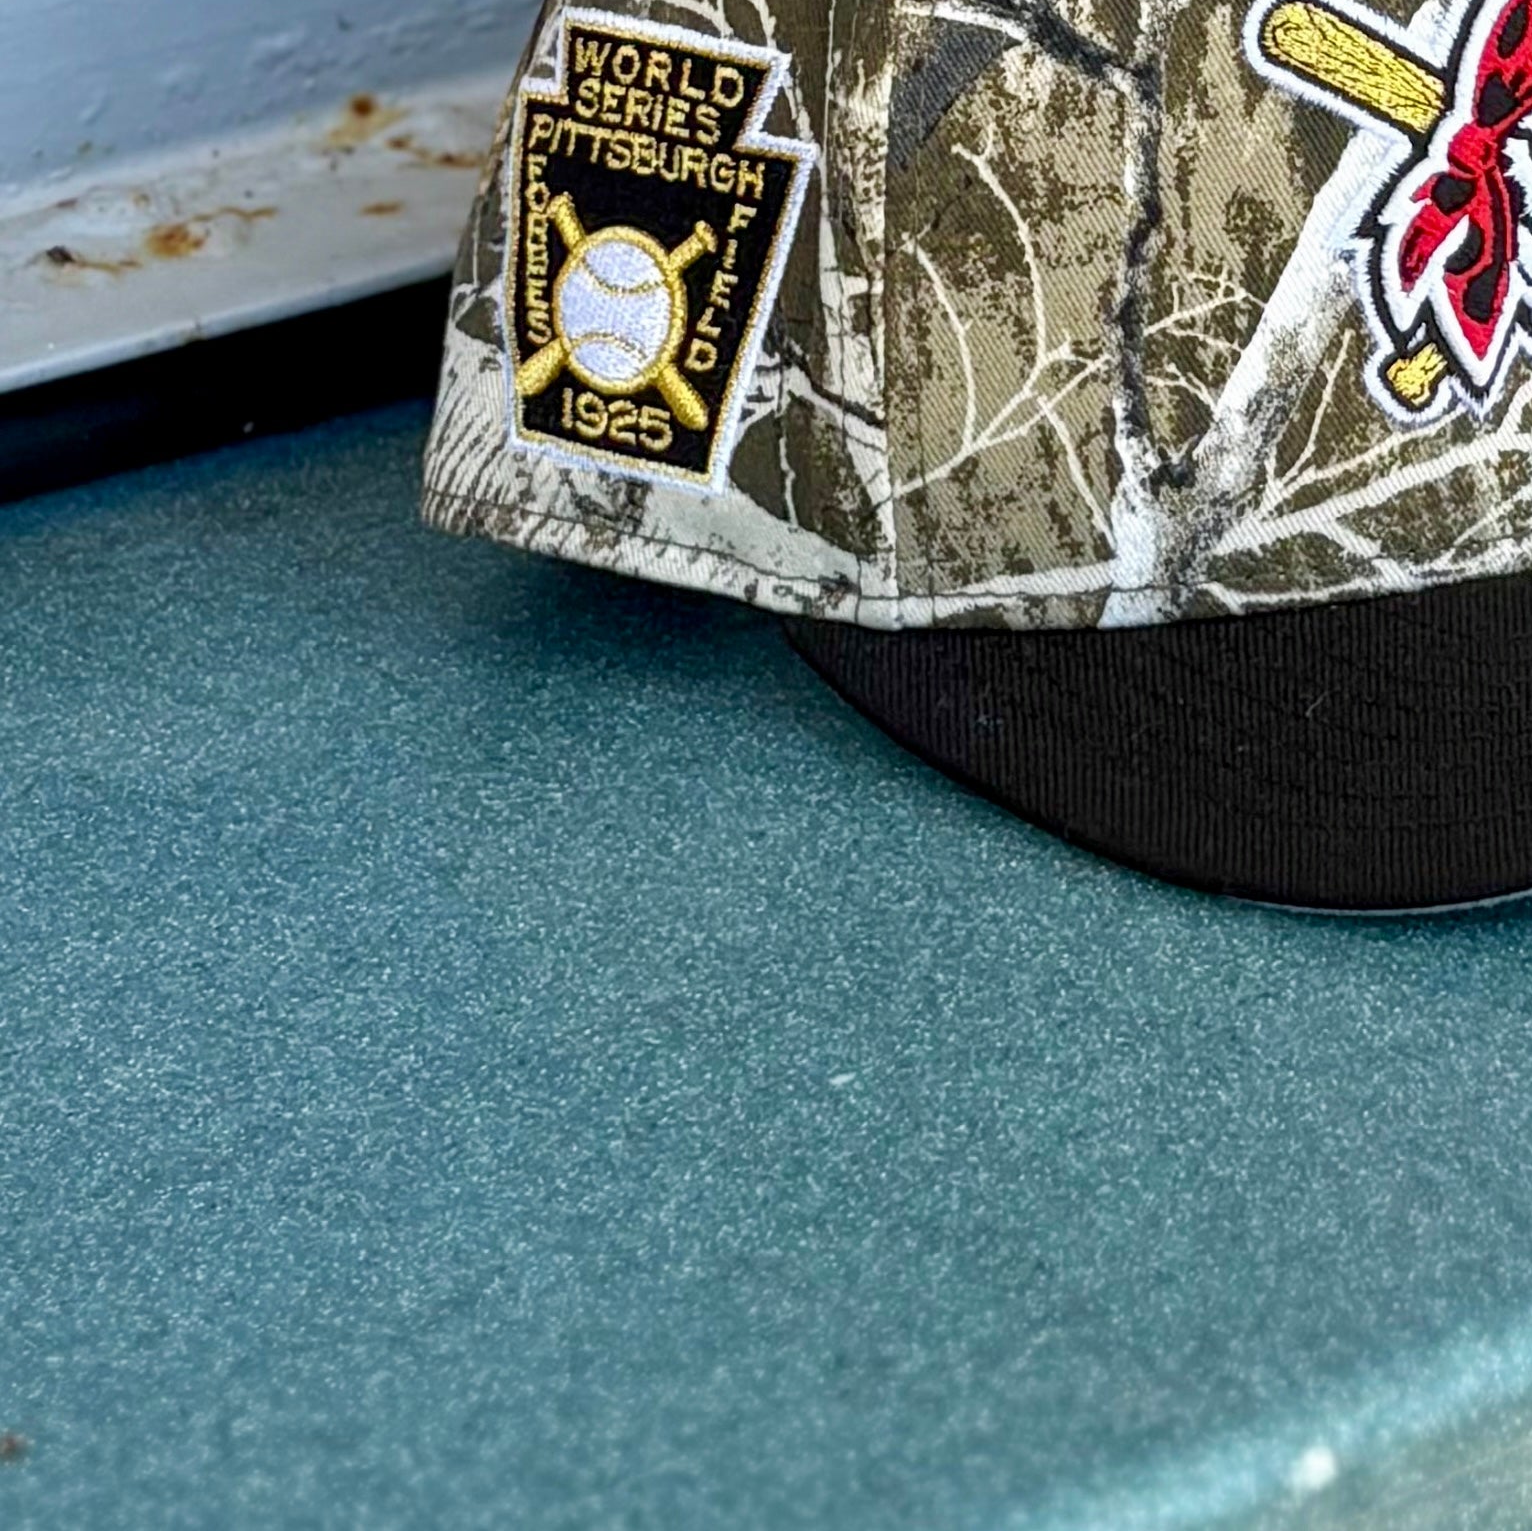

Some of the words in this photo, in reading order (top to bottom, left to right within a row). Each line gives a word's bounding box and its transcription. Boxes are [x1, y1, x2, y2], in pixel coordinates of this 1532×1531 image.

[574, 35, 745, 108] WORLD
[575, 77, 721, 146] SERIES
[528, 113, 765, 199] PITTSBURGH
[525, 153, 552, 346] FORBES
[684, 203, 758, 372] FIELD
[561, 387, 673, 452] 1925
